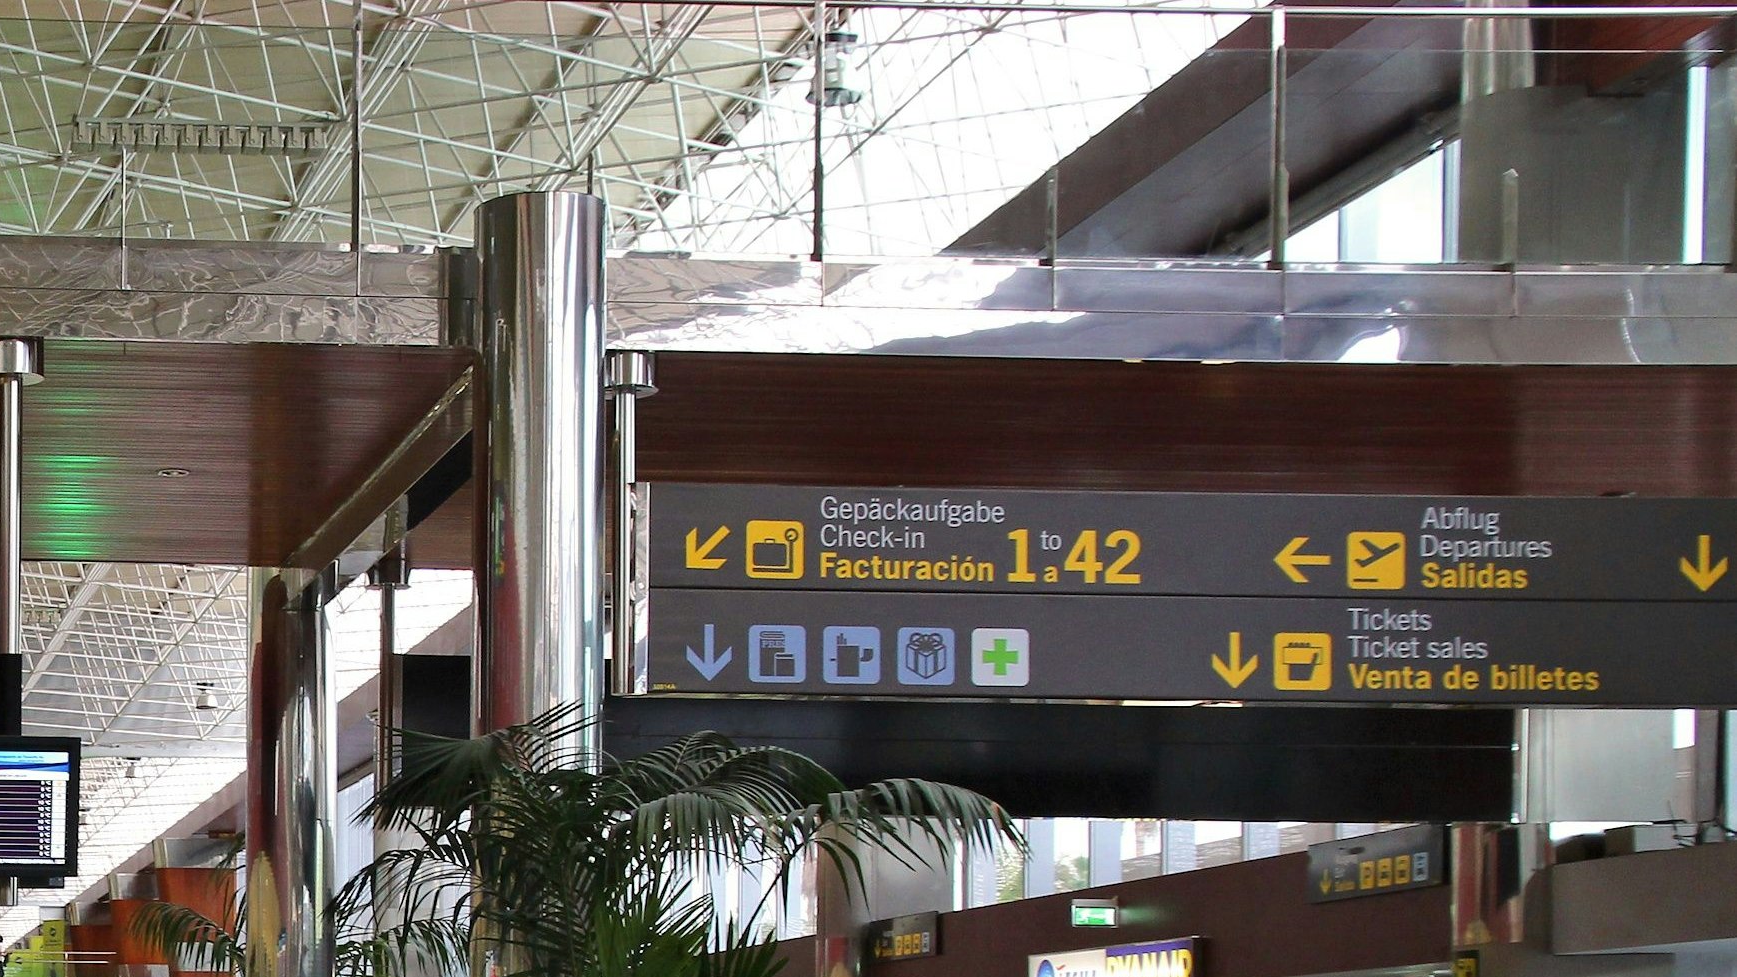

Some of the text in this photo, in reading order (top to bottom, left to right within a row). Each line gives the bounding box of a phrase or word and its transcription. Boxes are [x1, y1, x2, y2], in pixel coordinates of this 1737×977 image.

[819, 495, 1006, 527] Gepäckaufgabe
[1420, 506, 1501, 535] Abflug
[819, 525, 926, 549] Check-in
[1039, 530, 1063, 551] to
[1420, 535, 1553, 562] Departures
[819, 529, 1142, 585] Facturación 1 42
[1043, 564, 1059, 584] a
[1421, 562, 1529, 590] Salidas
[1348, 607, 1433, 633] Tickets
[1348, 636, 1489, 661] Ticket sales
[1349, 664, 1601, 692] Venta de billetes
